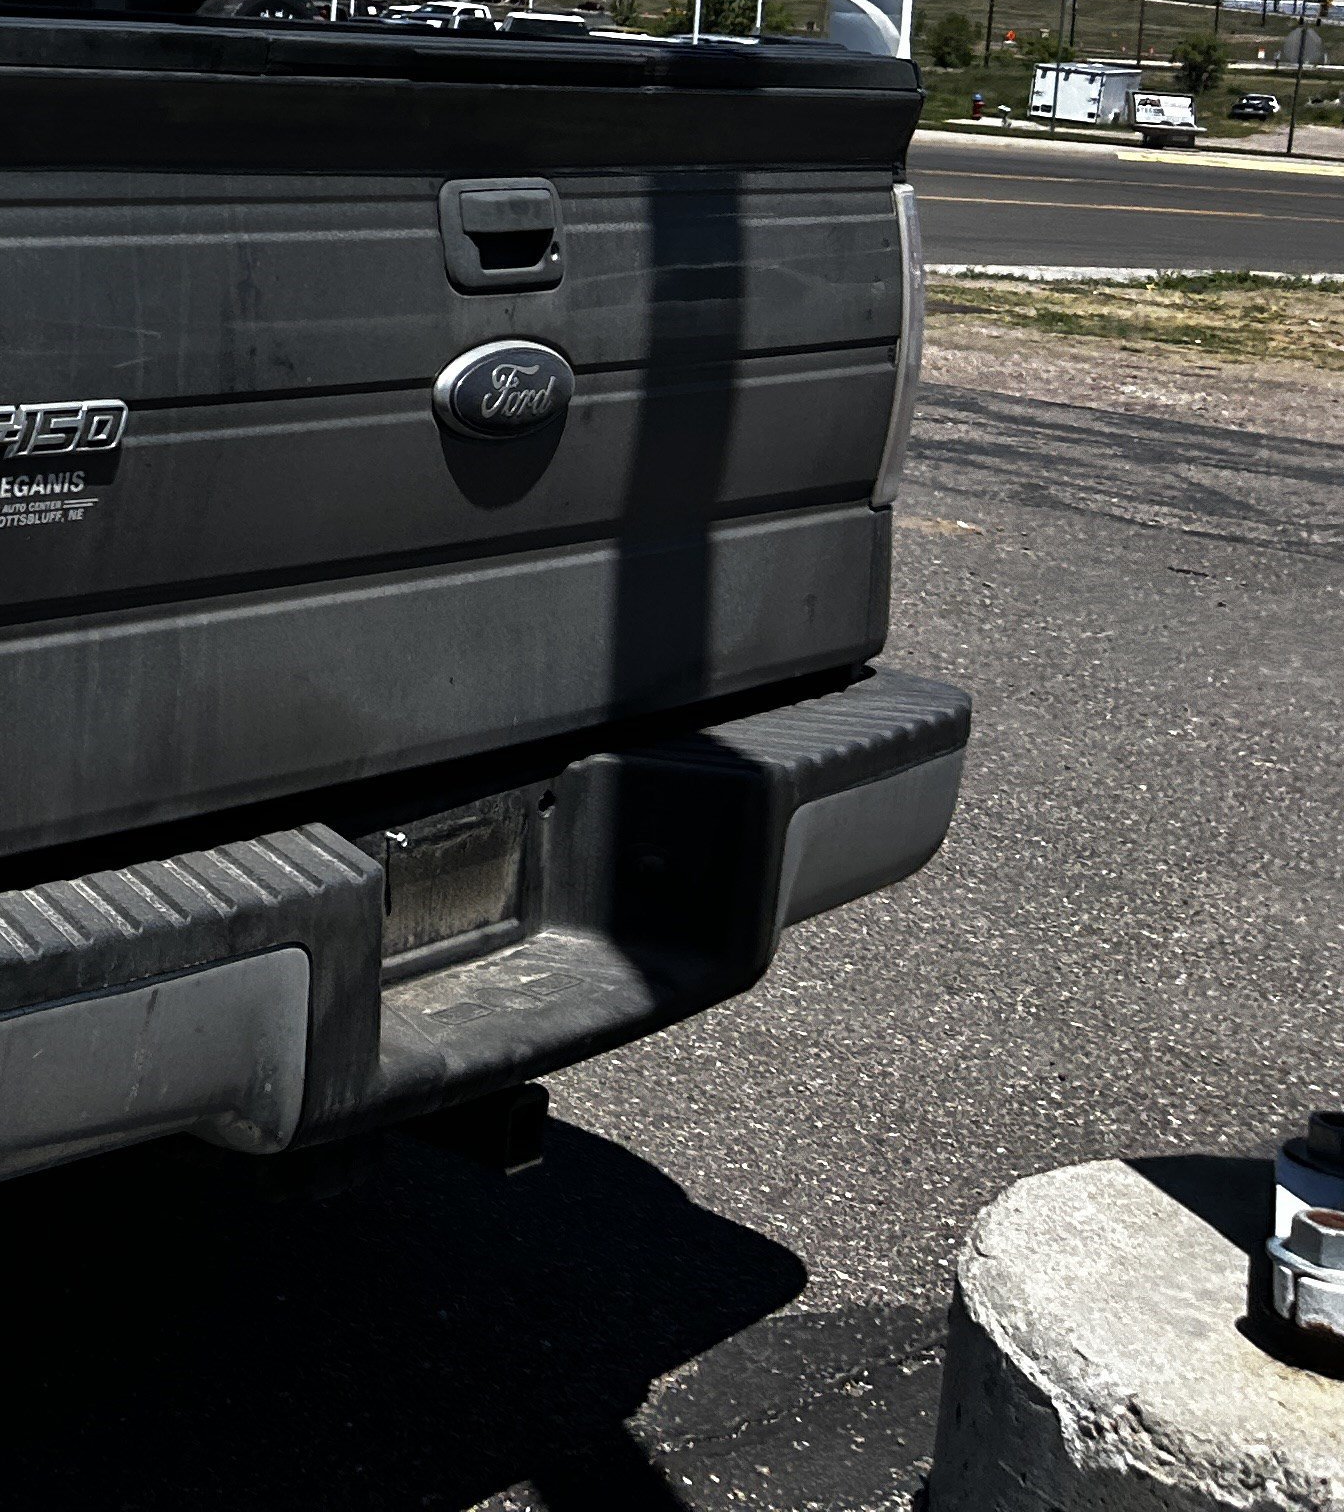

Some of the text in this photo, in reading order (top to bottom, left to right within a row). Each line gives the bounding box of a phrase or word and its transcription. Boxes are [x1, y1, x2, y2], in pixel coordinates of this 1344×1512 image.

[481, 364, 556, 419] Ford
[1, 500, 62, 514] AUTO CENTER
[67, 508, 85, 521] NE
